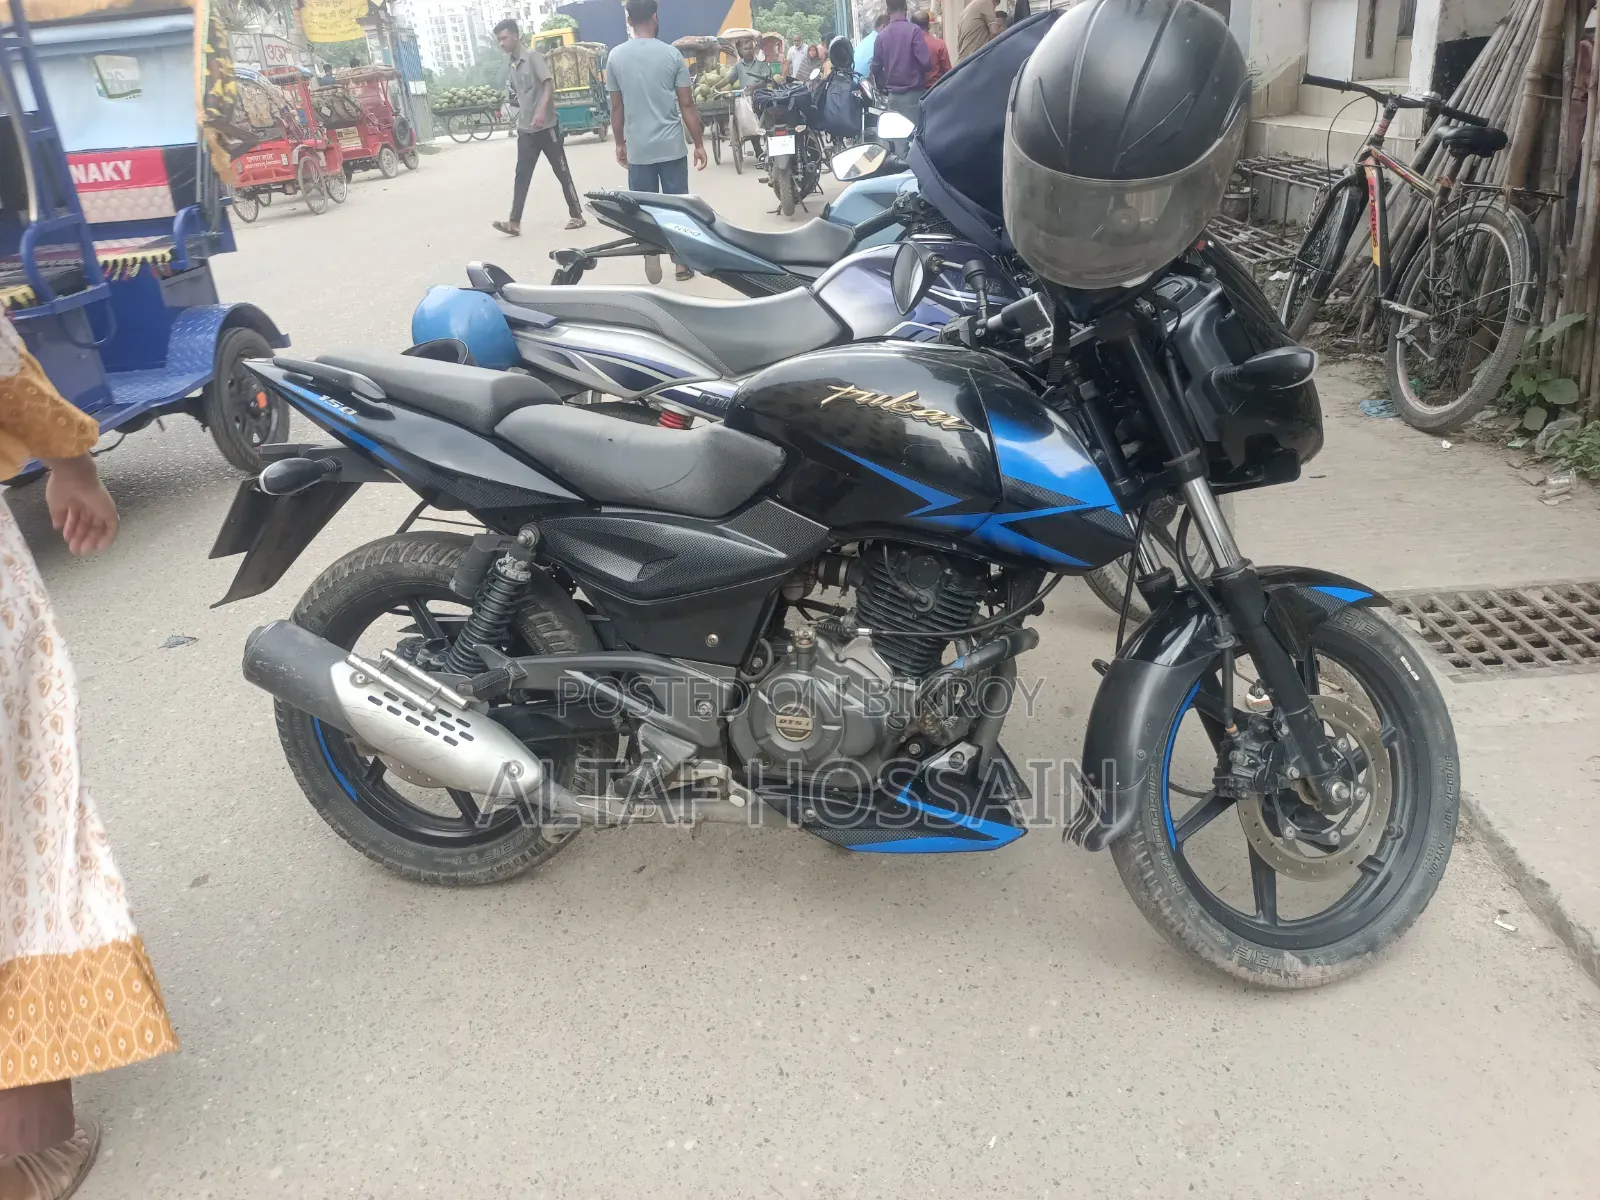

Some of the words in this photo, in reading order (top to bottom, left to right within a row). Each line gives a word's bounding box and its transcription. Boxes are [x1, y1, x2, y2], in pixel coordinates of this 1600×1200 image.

[318, 394, 358, 416] 150
[1148, 765, 1184, 893] NYLOGRIP
[1428, 842, 1446, 878] NYLON
